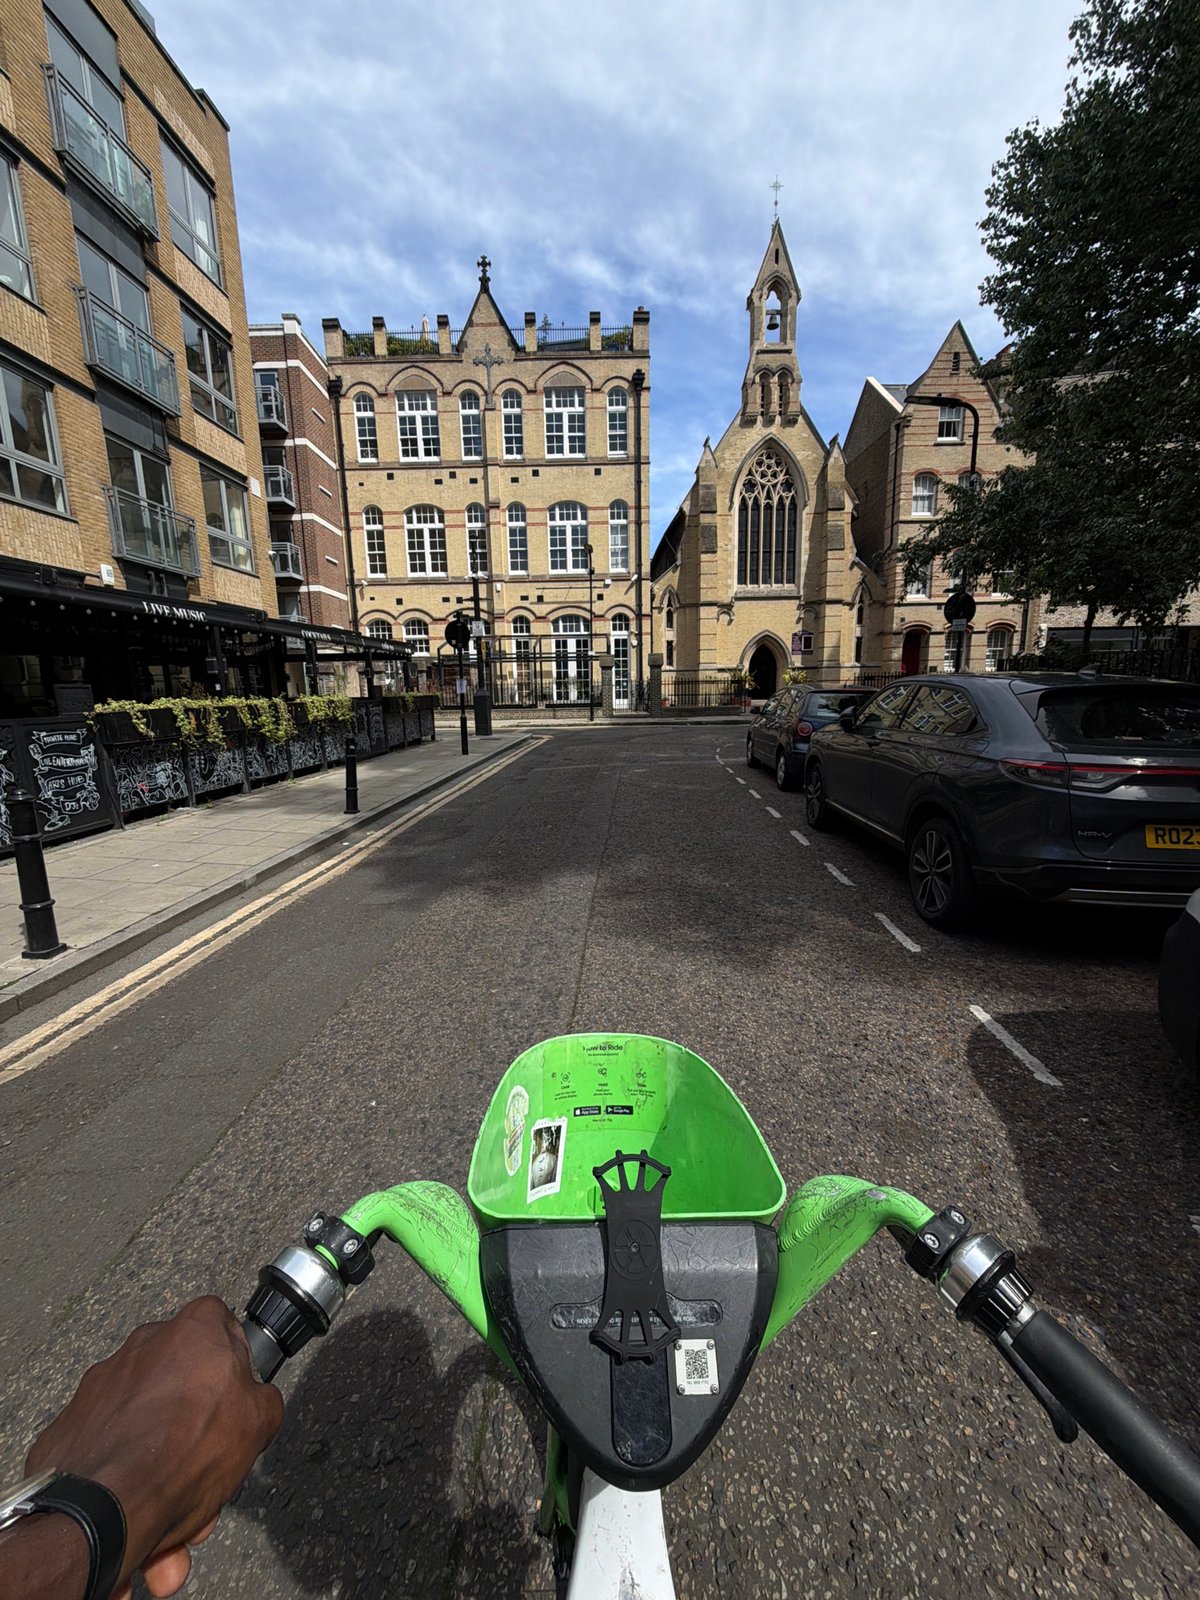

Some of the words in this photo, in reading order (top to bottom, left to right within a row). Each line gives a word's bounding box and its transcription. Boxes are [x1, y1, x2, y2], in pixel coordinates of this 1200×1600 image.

[142, 601, 172, 617] LIVE
[173, 607, 208, 622] MUSIC
[48, 780, 65, 790] ARTS
[67, 776, 85, 786] HUB
[1077, 830, 1113, 839] HR-V
